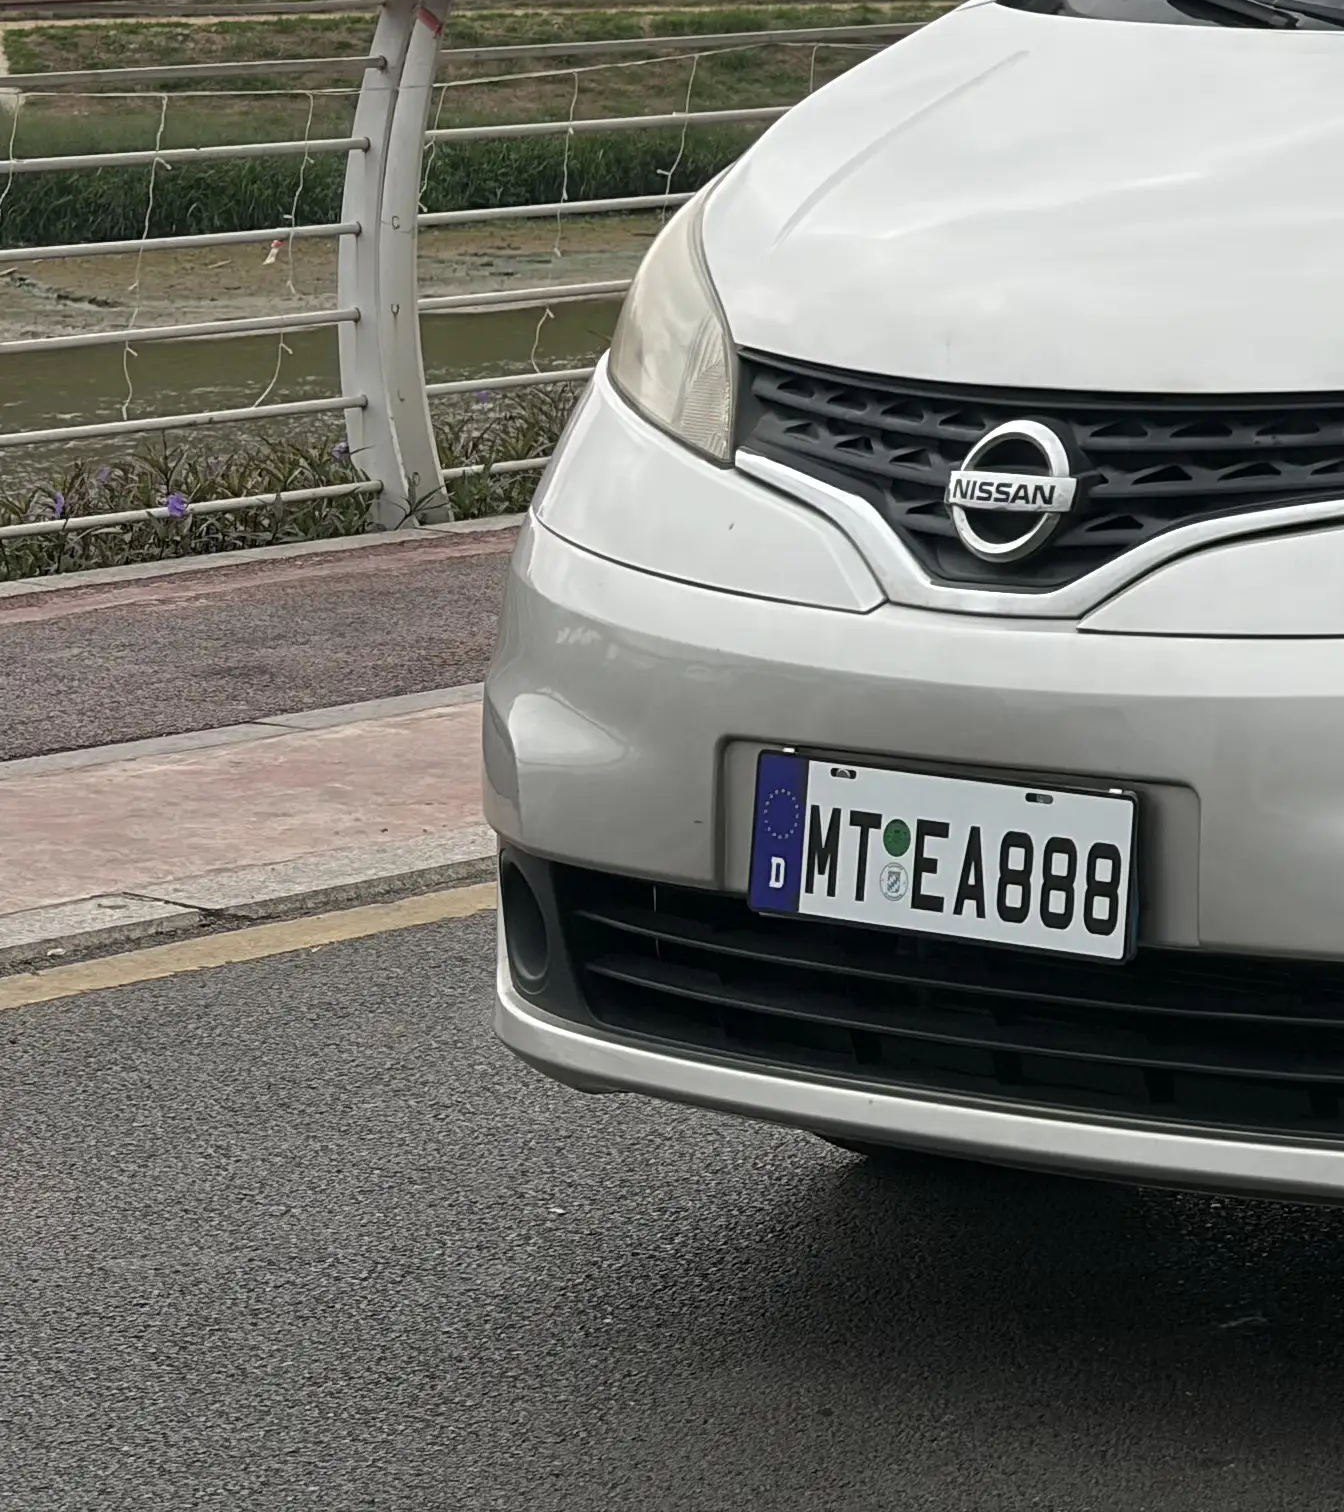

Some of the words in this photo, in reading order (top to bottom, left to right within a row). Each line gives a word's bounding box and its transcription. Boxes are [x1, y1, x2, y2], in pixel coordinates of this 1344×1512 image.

[952, 478, 1056, 506] NISSAN
[768, 856, 785, 889] D
[804, 804, 882, 903] MT
[910, 818, 1122, 937] EA888
